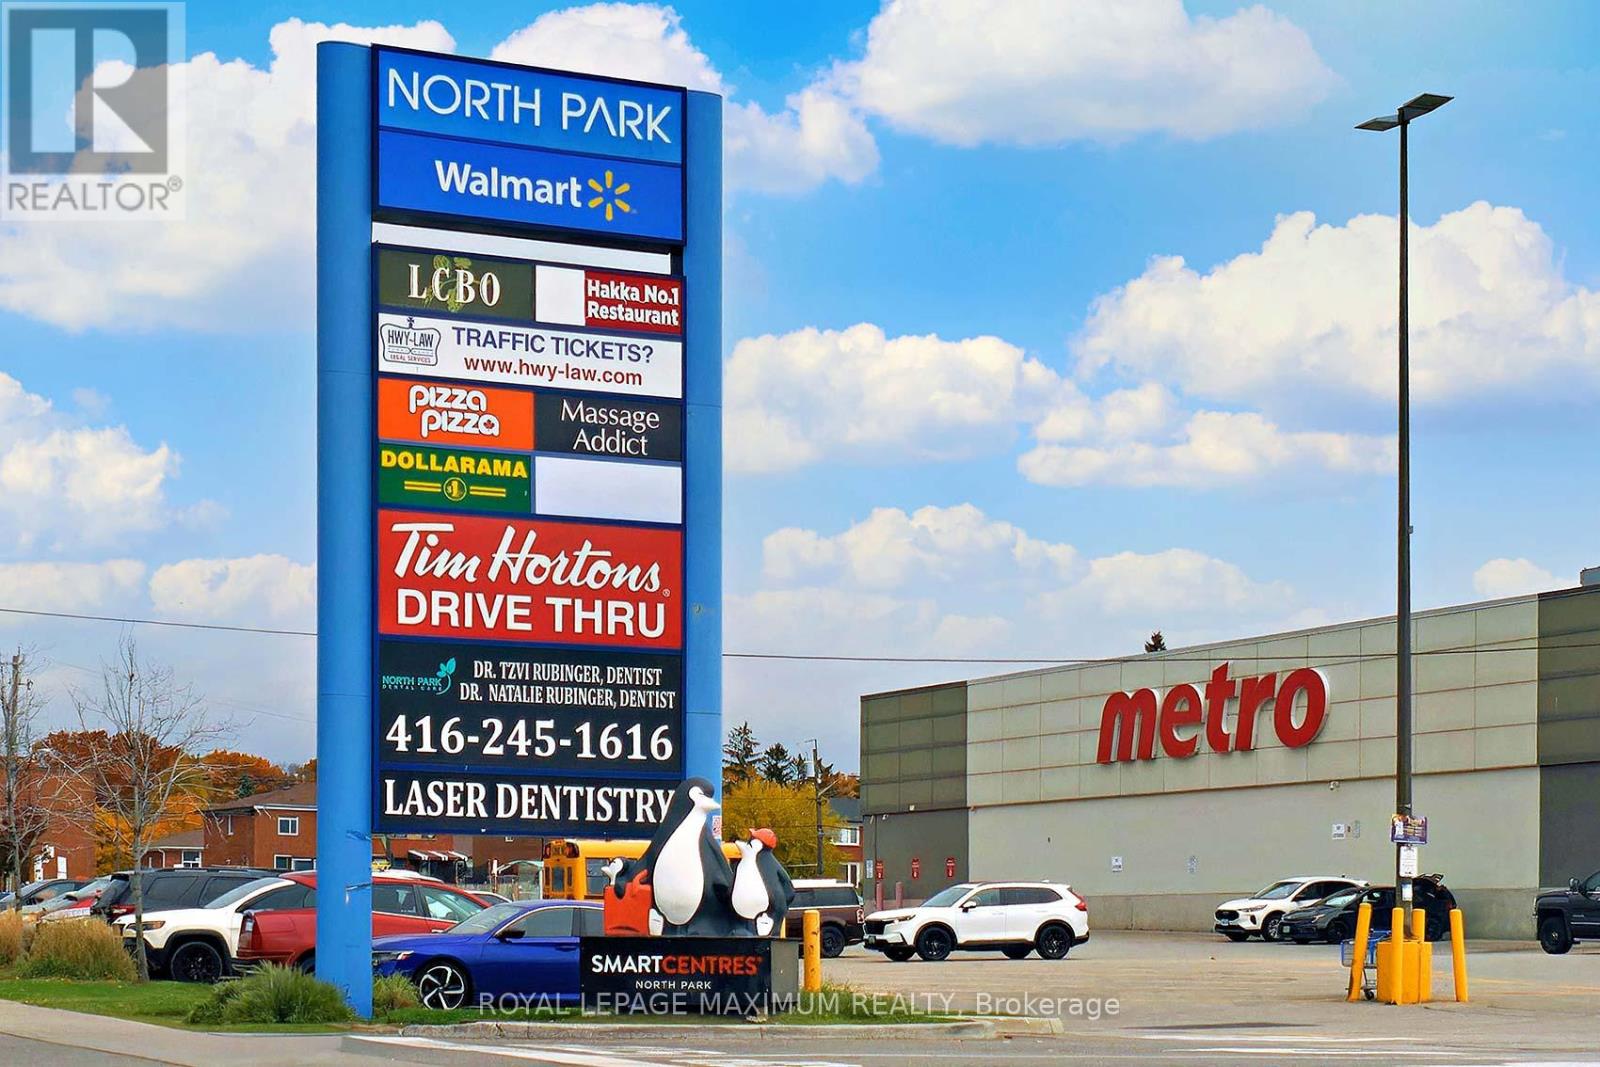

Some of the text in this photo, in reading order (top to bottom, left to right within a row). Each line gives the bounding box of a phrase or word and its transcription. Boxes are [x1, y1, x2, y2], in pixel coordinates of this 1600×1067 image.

[388, 68, 673, 144] NORTH PARK
[434, 159, 583, 208] Walmart
[407, 263, 501, 308] LCBO
[587, 279, 679, 305] Hakka No.1
[587, 300, 679, 326] Restaurant
[387, 329, 434, 348] HWY-LAW
[451, 326, 654, 363] TRAFFIC TICKETS?
[464, 356, 643, 386] www.hwy-law.com
[408, 385, 487, 414] pizza
[420, 409, 501, 438] pizza
[561, 399, 660, 434] Massage
[572, 429, 649, 456] Addict
[380, 450, 528, 479] DOLLARAMA
[391, 522, 482, 583] Tim
[397, 588, 666, 639] DRIVE THRU
[382, 675, 442, 687] NORTH PARK
[473, 660, 663, 686] DR. TZVI RUBINGER, DENTIST
[459, 682, 676, 709] DR. NATALIE RUBINGER, DENTIST
[1096, 660, 1330, 765] metro
[385, 714, 674, 761] 416-245-1616
[384, 779, 676, 824] LASER DENTISTRY
[591, 954, 759, 975] SMARTCENTRES
[635, 980, 712, 990] NORTH PARK
